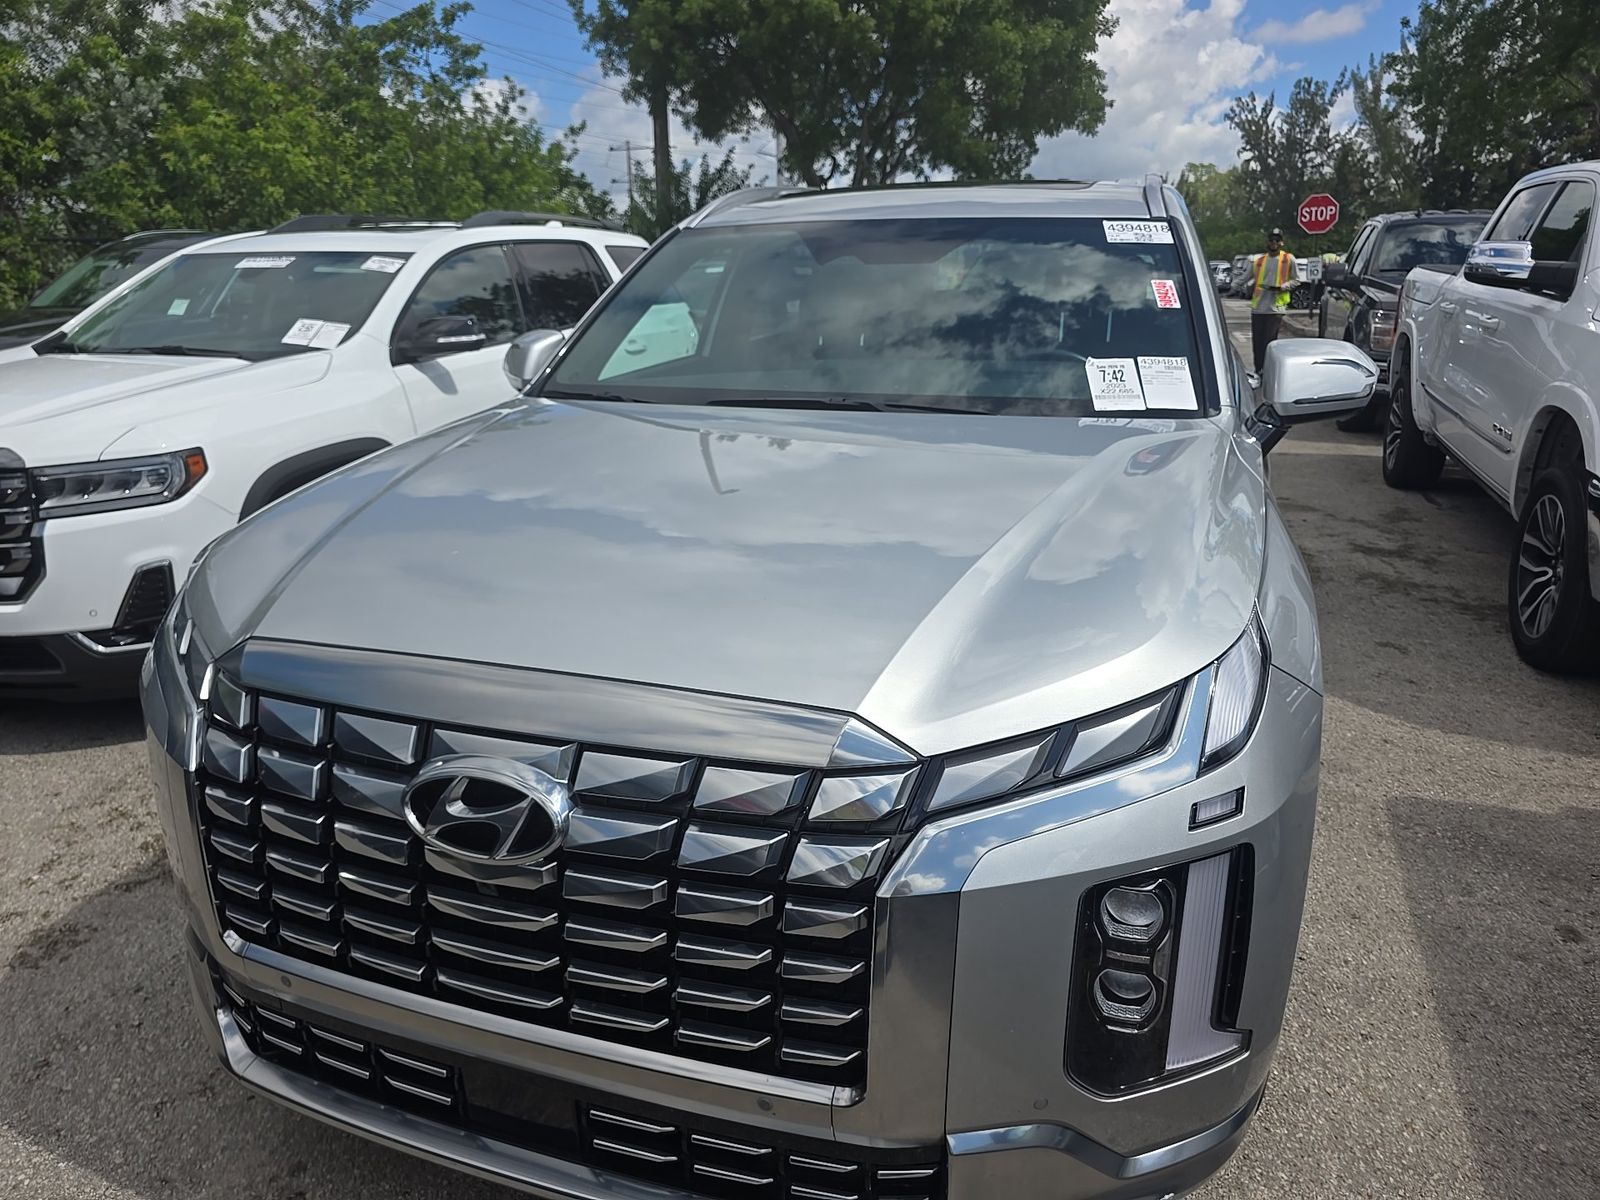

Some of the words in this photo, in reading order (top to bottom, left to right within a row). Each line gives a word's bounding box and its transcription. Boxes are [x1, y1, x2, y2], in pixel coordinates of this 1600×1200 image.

[1301, 206, 1336, 222] STOP
[1107, 223, 1170, 233] 4394818
[1098, 369, 1126, 383] 7:42
